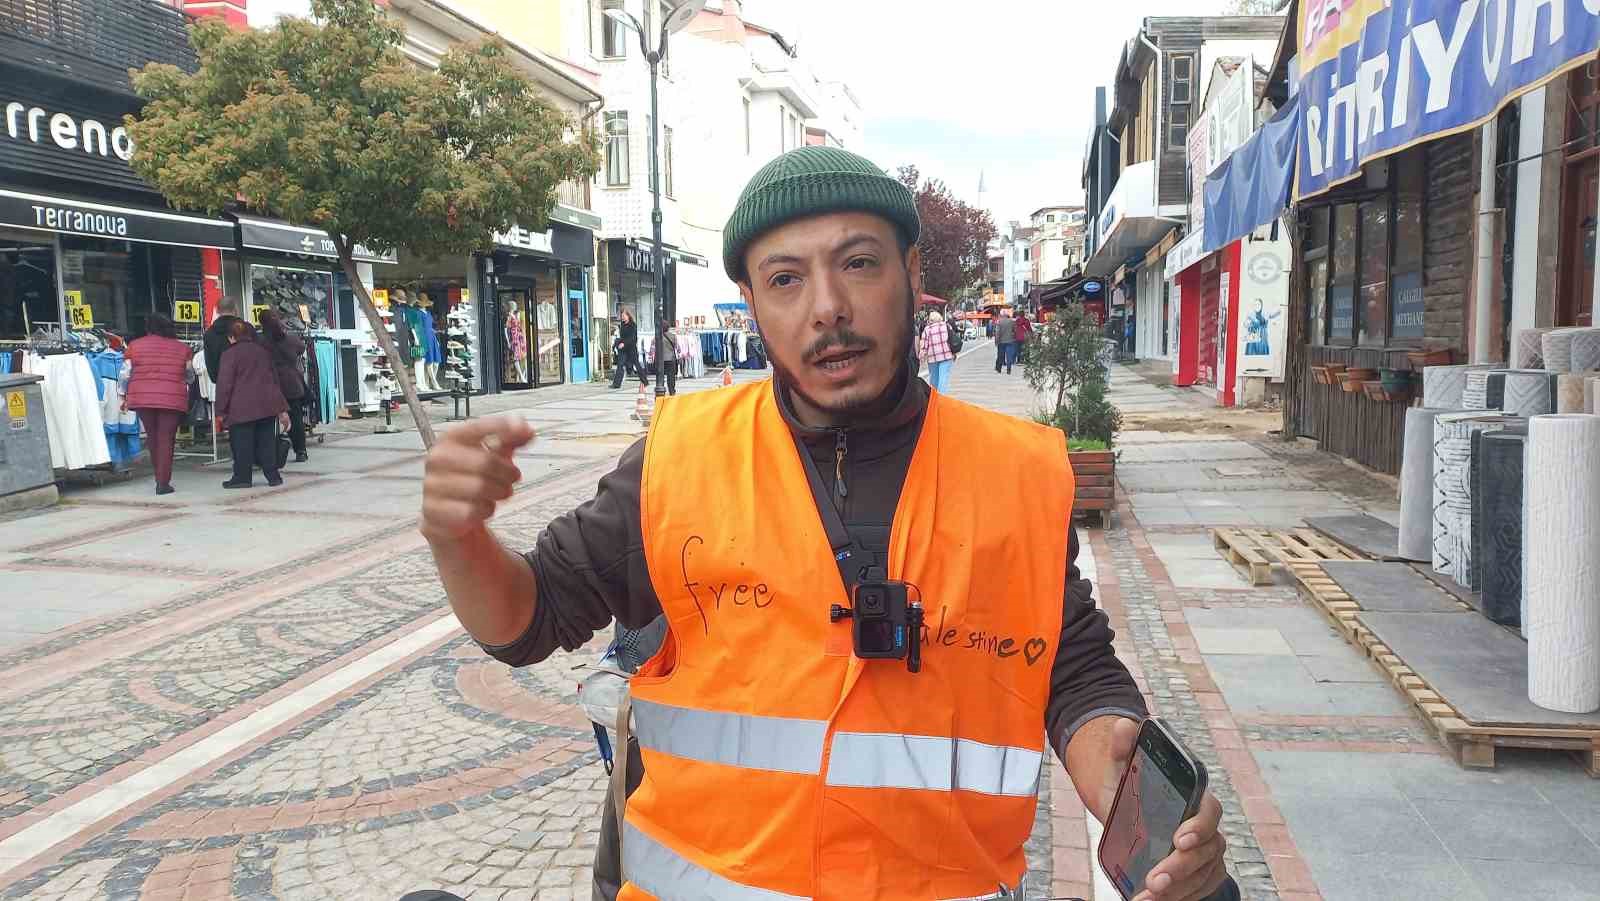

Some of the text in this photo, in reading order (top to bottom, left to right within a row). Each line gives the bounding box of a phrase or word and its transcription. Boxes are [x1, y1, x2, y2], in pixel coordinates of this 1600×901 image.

[178, 304, 193, 320] 13
[681, 535, 777, 635] free
[918, 605, 1020, 658] alestine
